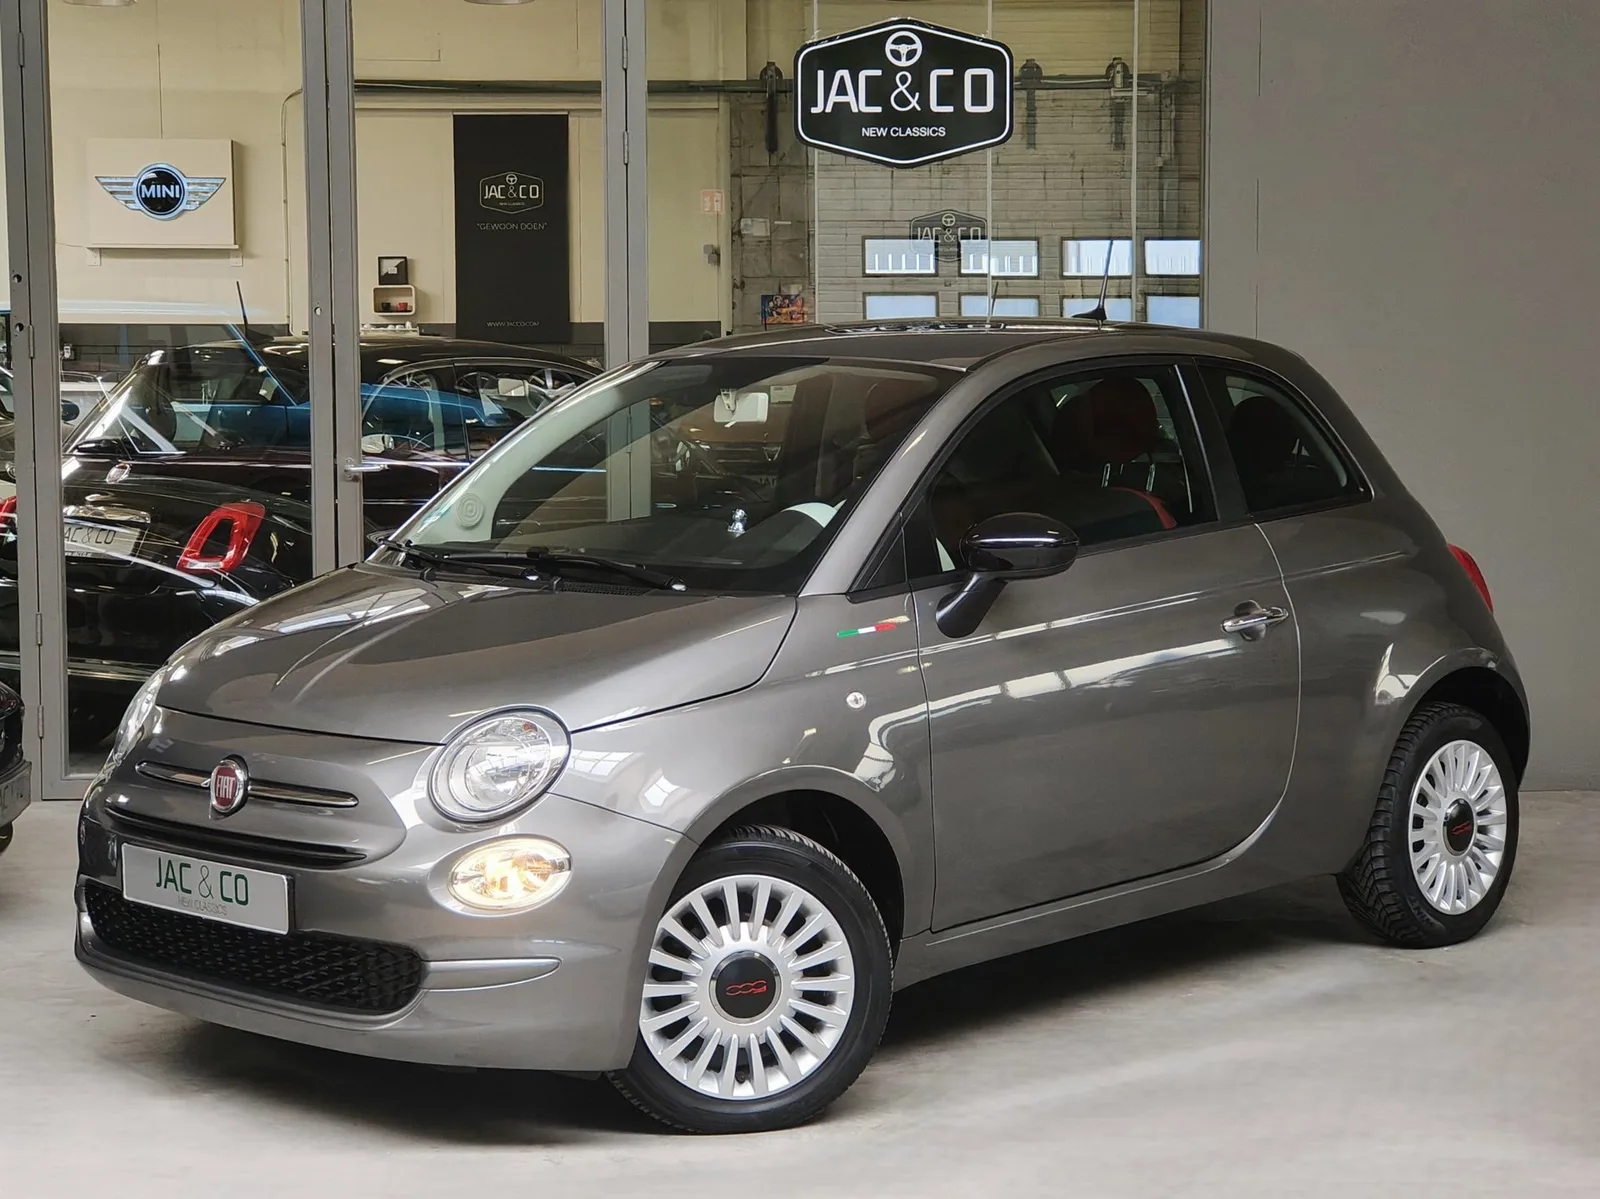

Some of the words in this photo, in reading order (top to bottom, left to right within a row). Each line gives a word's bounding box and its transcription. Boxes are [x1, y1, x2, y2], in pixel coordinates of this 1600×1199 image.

[810, 69, 883, 114] JAC
[890, 70, 922, 112] &
[861, 126, 888, 137] NEW
[890, 126, 946, 137] CLASSICS
[141, 185, 180, 198] MINI
[483, 184, 507, 199] JAC
[507, 185, 518, 199] &
[63, 526, 83, 543] AC
[216, 775, 235, 799] FIAT
[155, 856, 193, 895] JAC
[198, 864, 215, 899] &
[219, 870, 249, 906] CO
